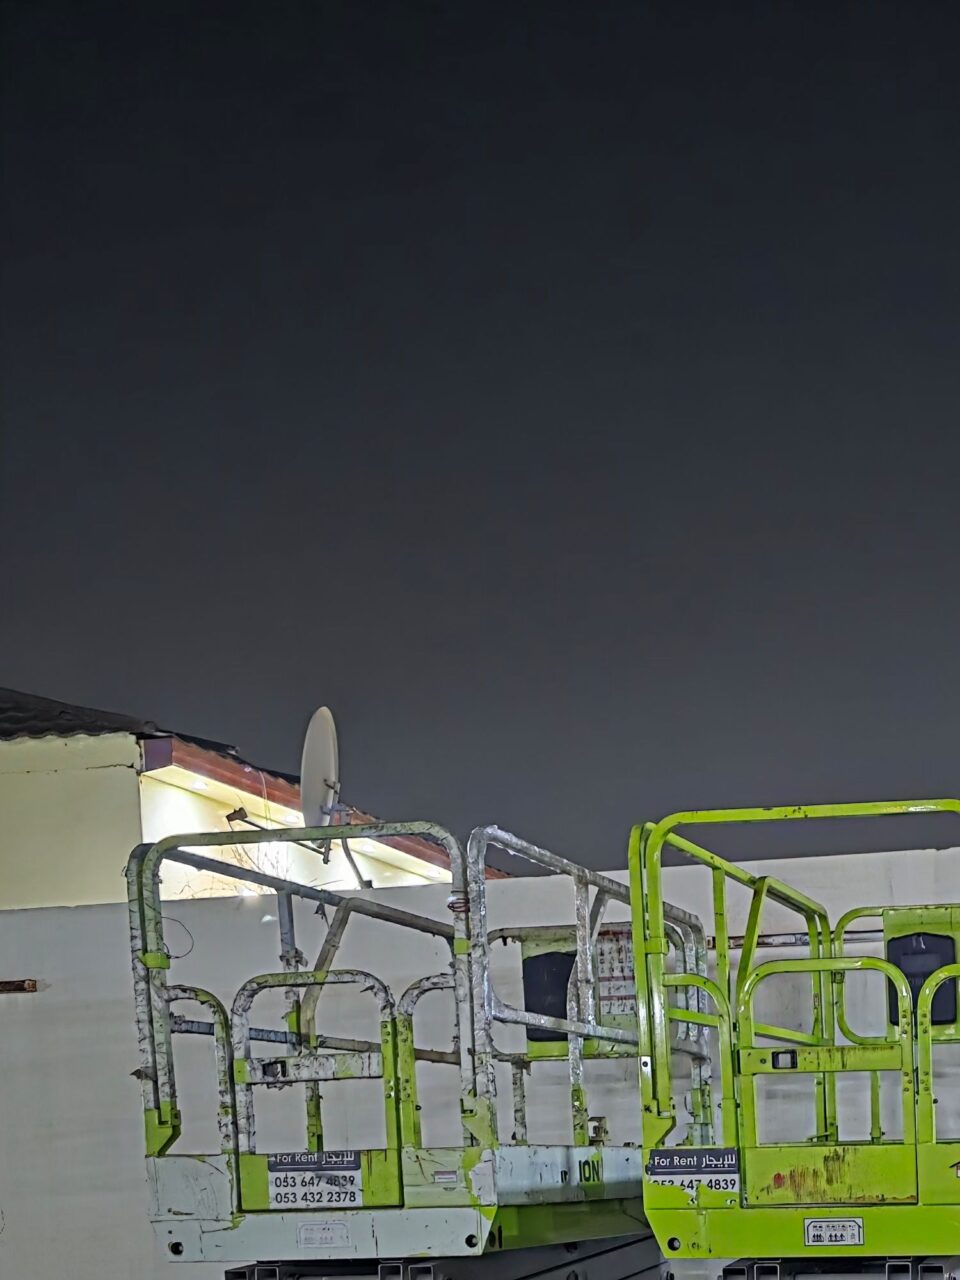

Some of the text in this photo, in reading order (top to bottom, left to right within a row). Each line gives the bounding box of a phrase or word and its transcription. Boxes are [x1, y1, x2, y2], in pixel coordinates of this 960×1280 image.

[276, 1153, 318, 1163] For Rent
[654, 1155, 697, 1166] For Rent
[701, 1153, 736, 1168] للإيجار
[274, 1175, 355, 1188] 053 647 4839
[706, 1178, 737, 1191] 4839
[275, 1191, 357, 1204] 053 432 2378
